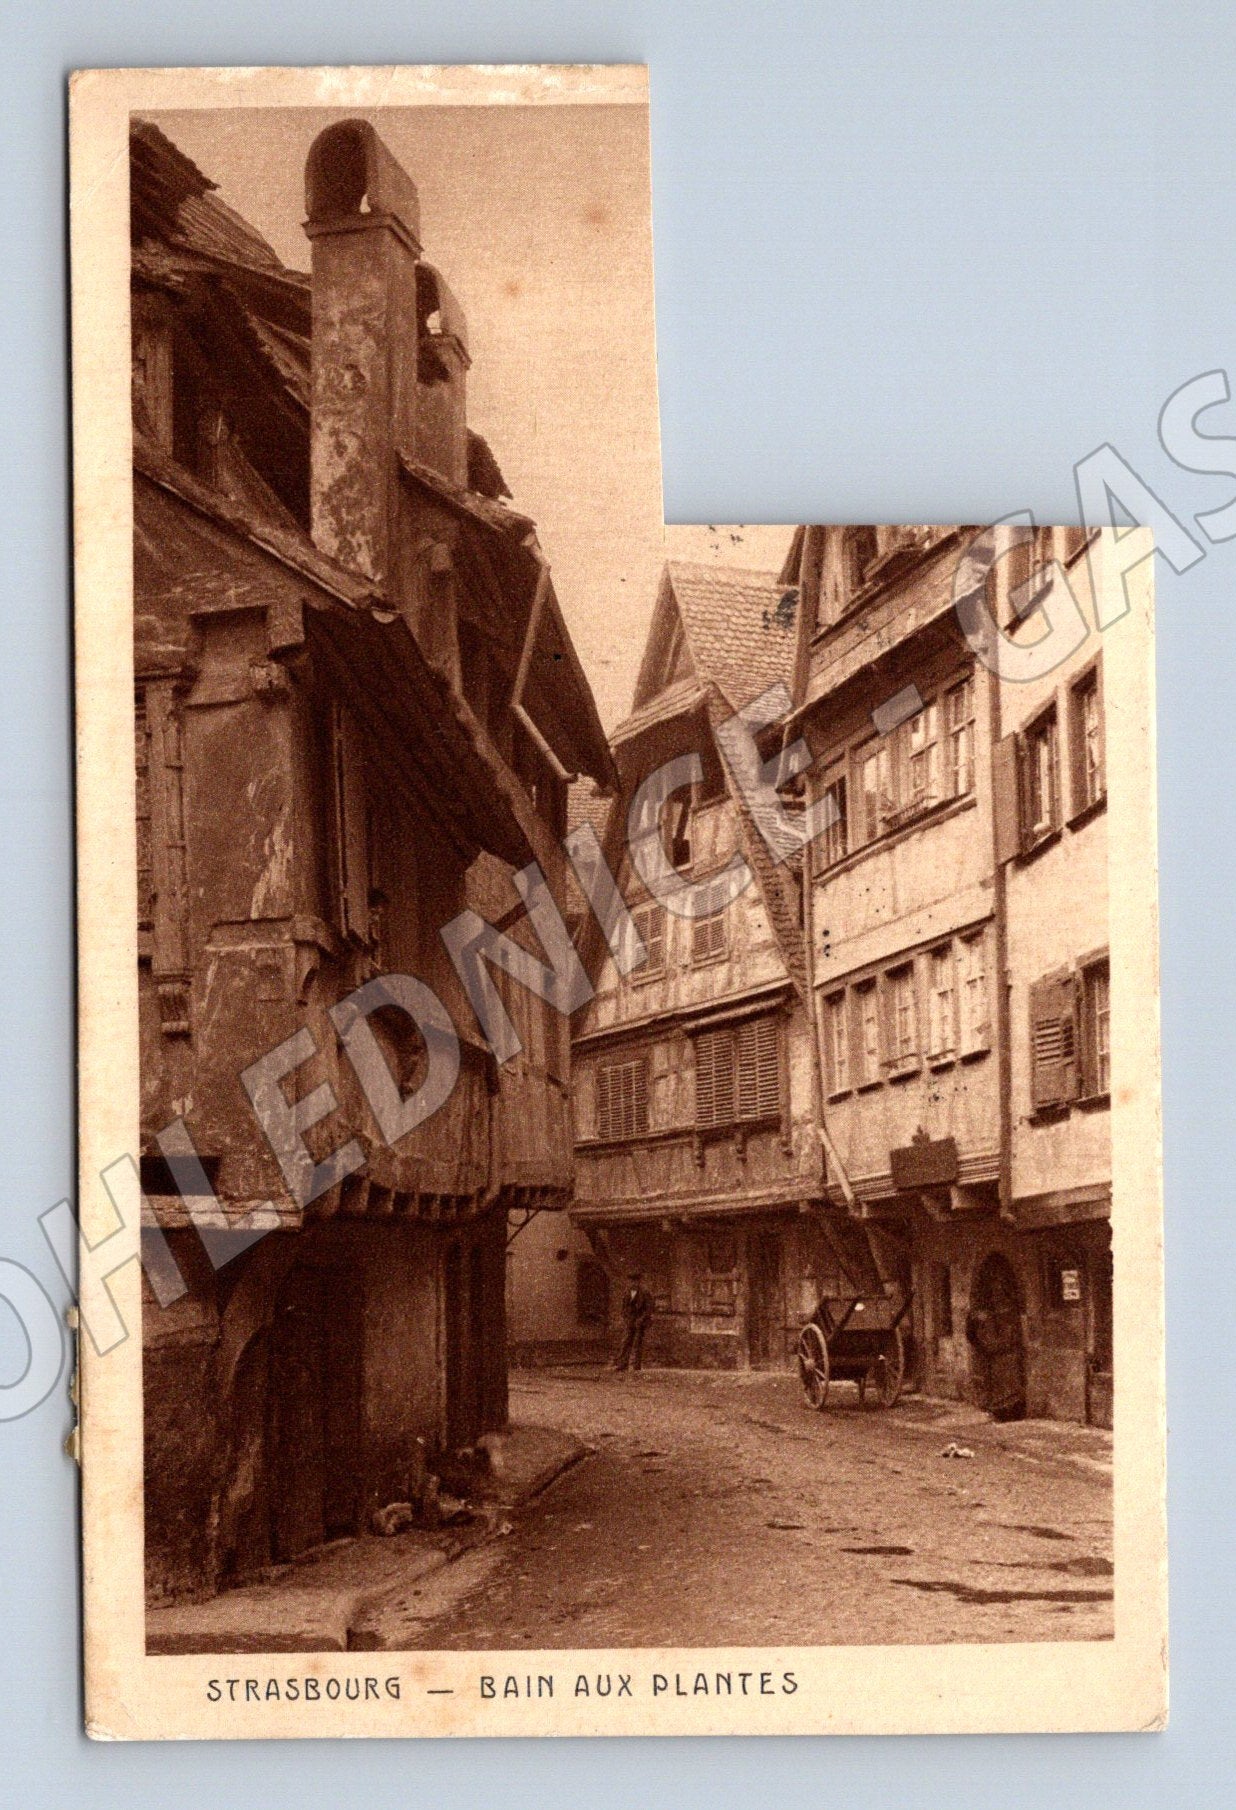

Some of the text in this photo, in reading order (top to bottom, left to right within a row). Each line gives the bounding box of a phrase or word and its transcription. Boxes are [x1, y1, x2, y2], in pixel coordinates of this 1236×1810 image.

[206, 1676, 401, 1702] STRASBOURG
[480, 1674, 553, 1699] BAIN
[574, 1673, 633, 1697] AUX
[652, 1671, 798, 1697] PLANTES
